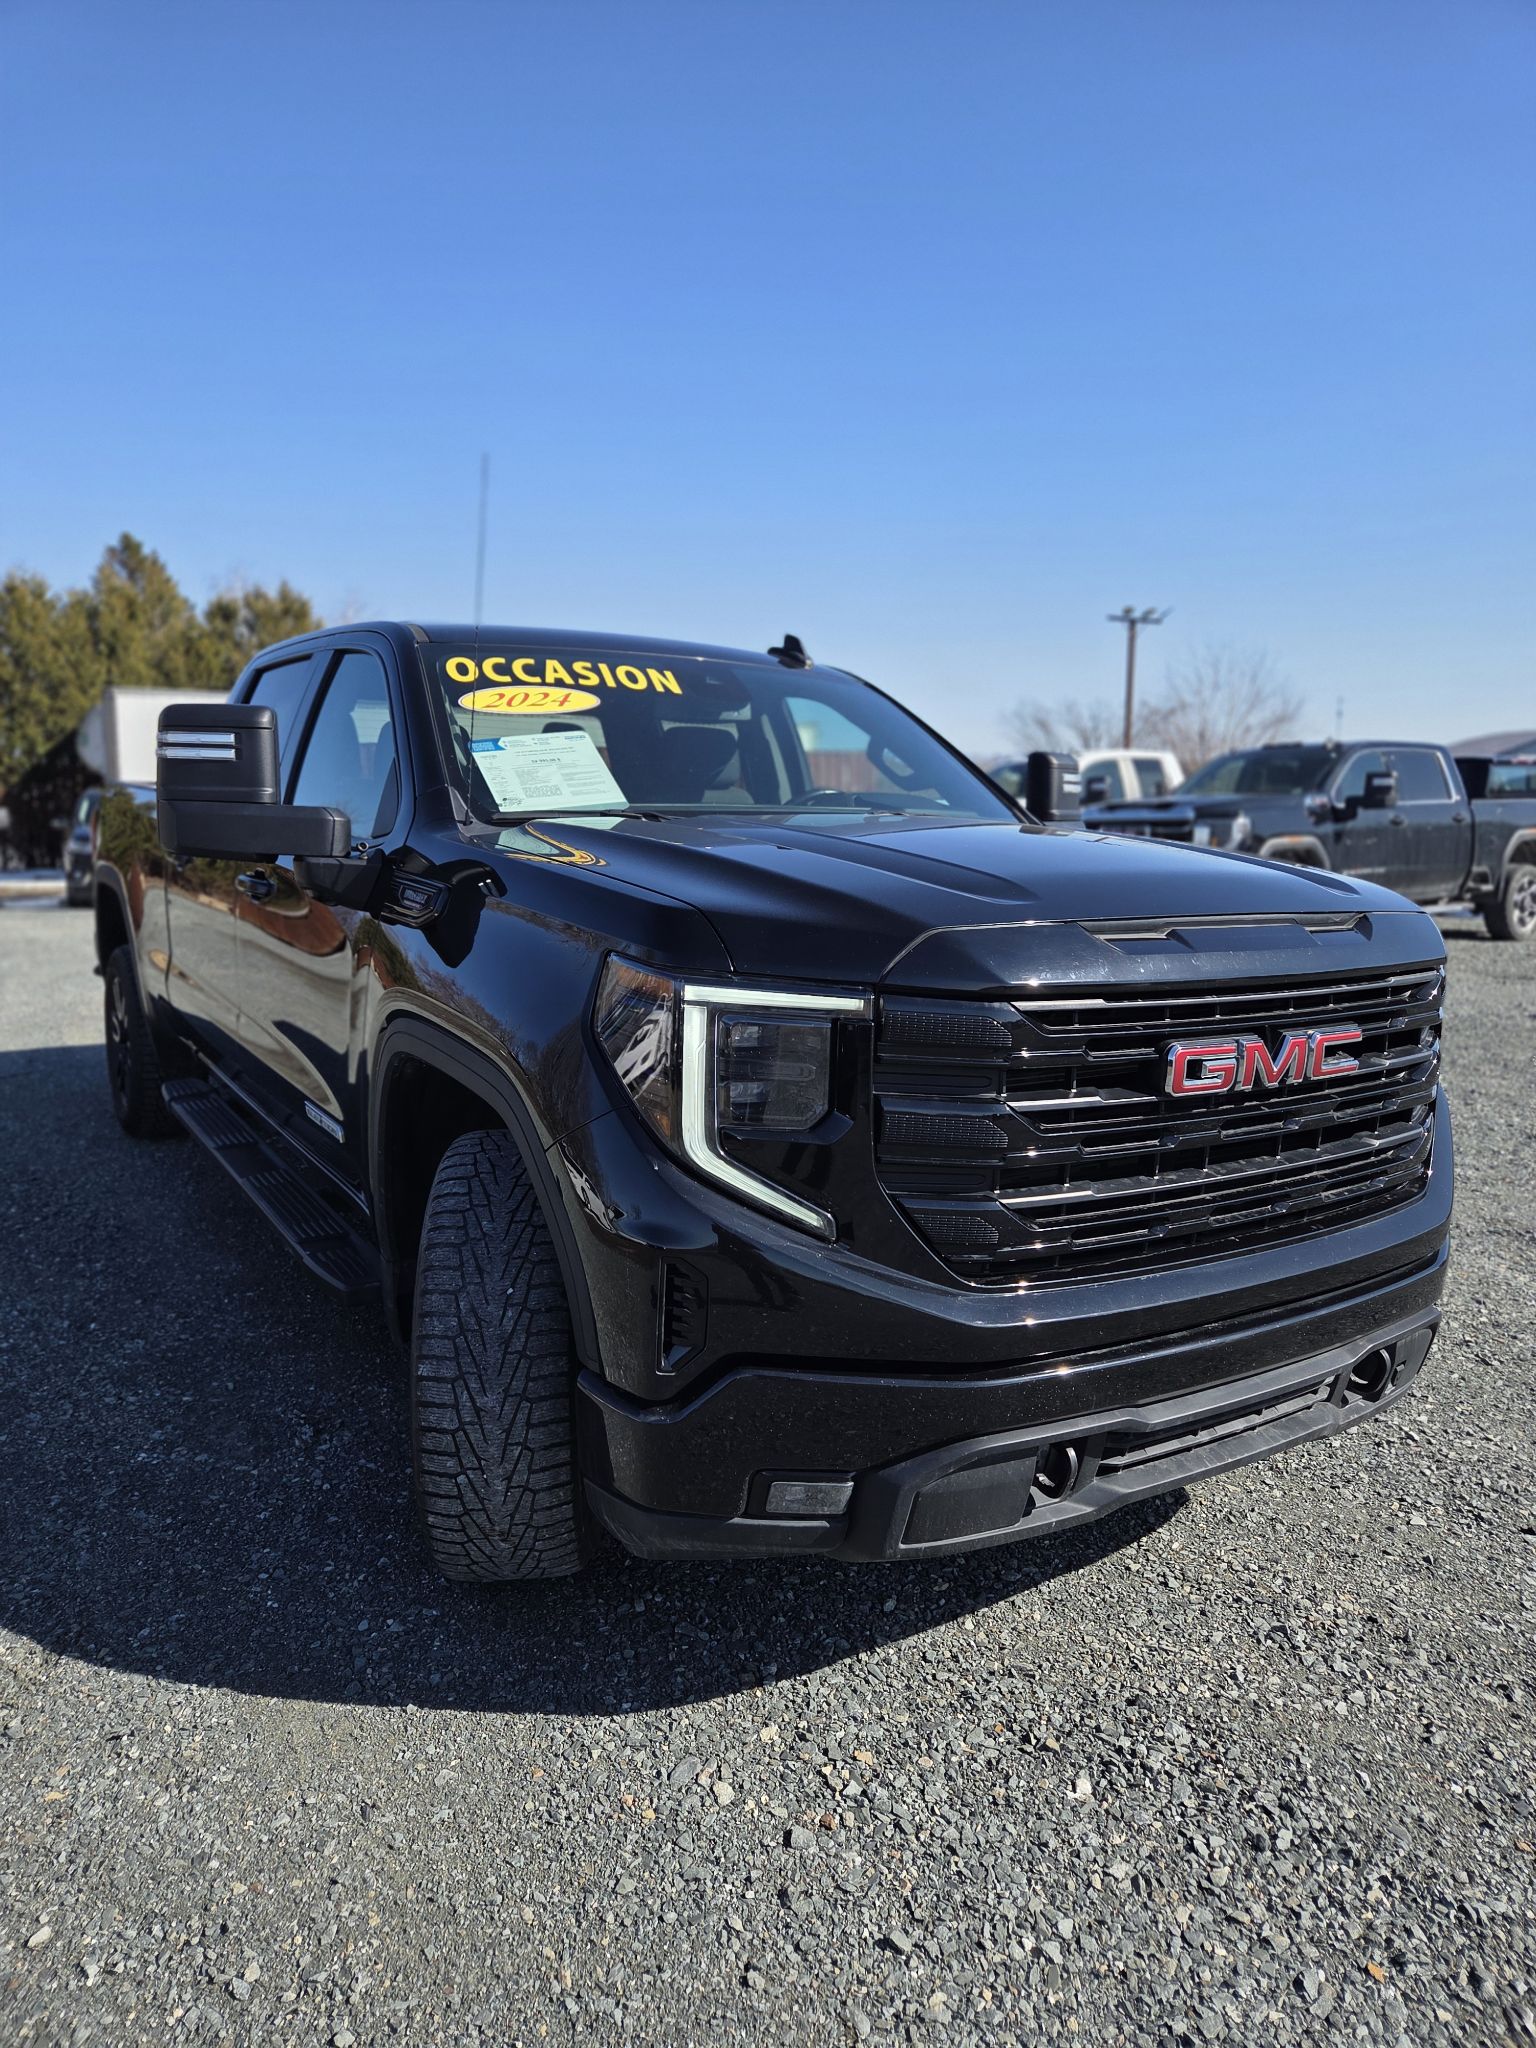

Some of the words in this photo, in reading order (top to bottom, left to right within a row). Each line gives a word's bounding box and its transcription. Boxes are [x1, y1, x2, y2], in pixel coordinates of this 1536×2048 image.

[445, 656, 683, 695] OCCASION
[482, 691, 572, 709] 2024
[1165, 1024, 1363, 1097] GMC
